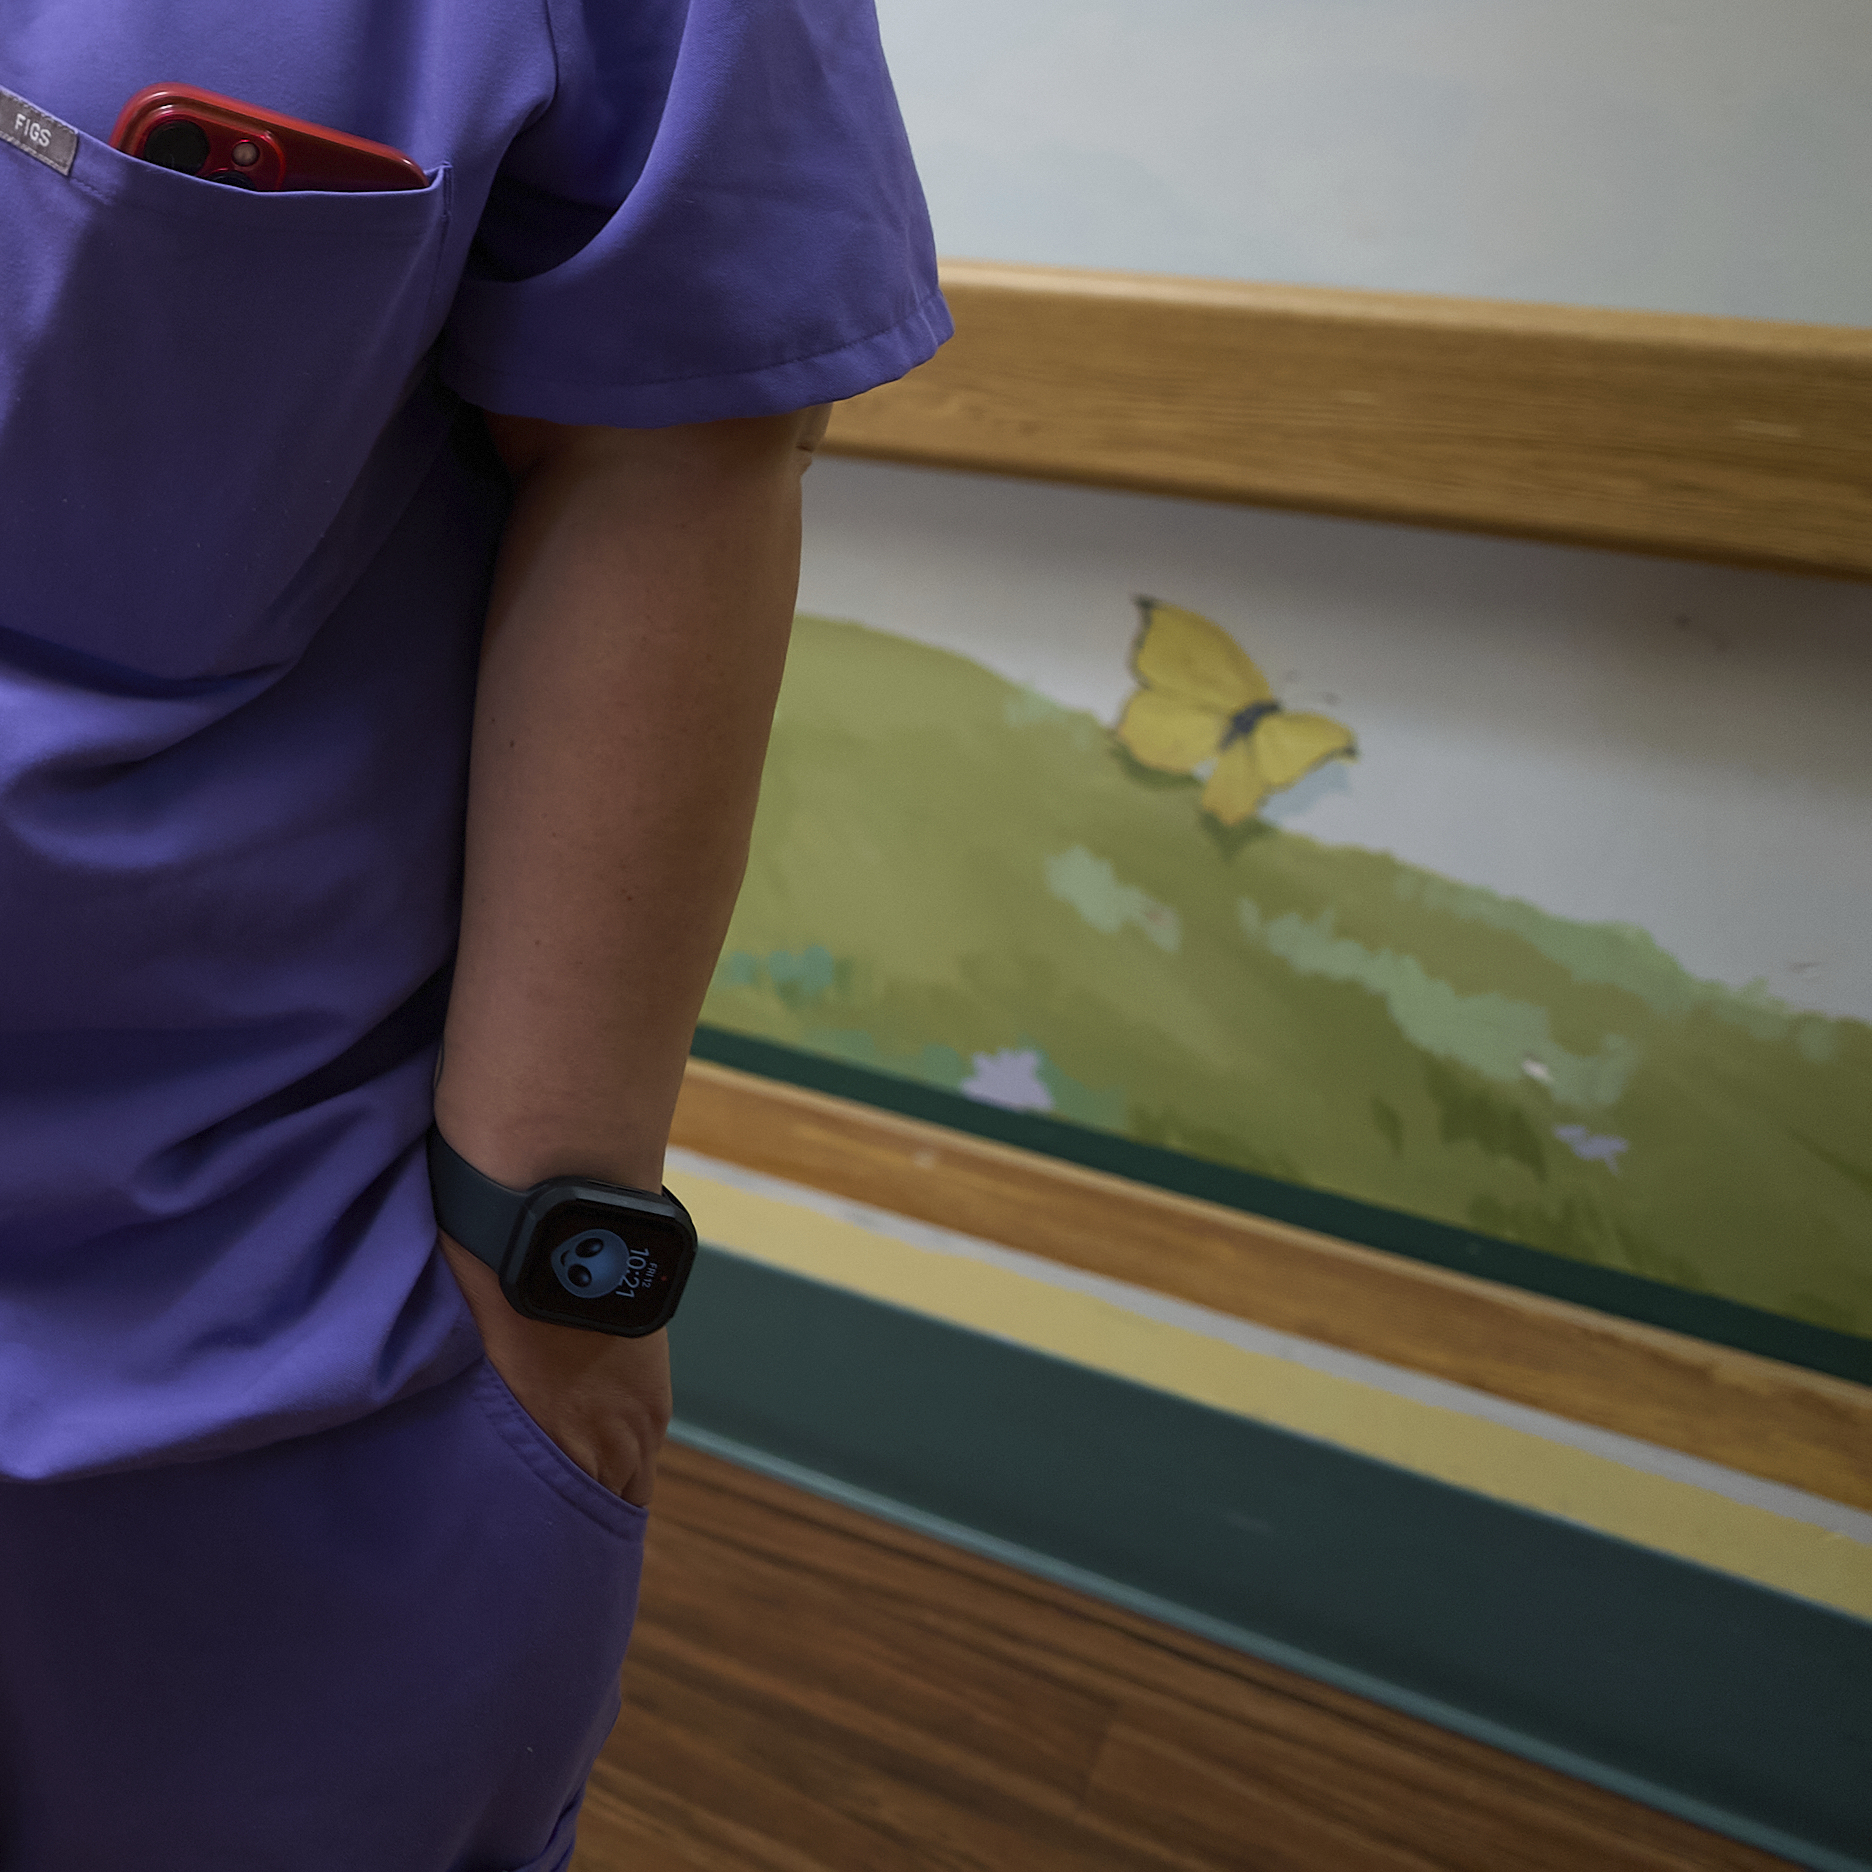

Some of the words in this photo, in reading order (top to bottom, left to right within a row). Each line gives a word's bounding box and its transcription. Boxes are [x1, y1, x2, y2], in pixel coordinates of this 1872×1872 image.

[14, 113, 52, 147] FIGS
[616, 1248, 650, 1297] 10:21
[645, 1262, 658, 1277] FRI
[641, 1278, 653, 1288] 12
